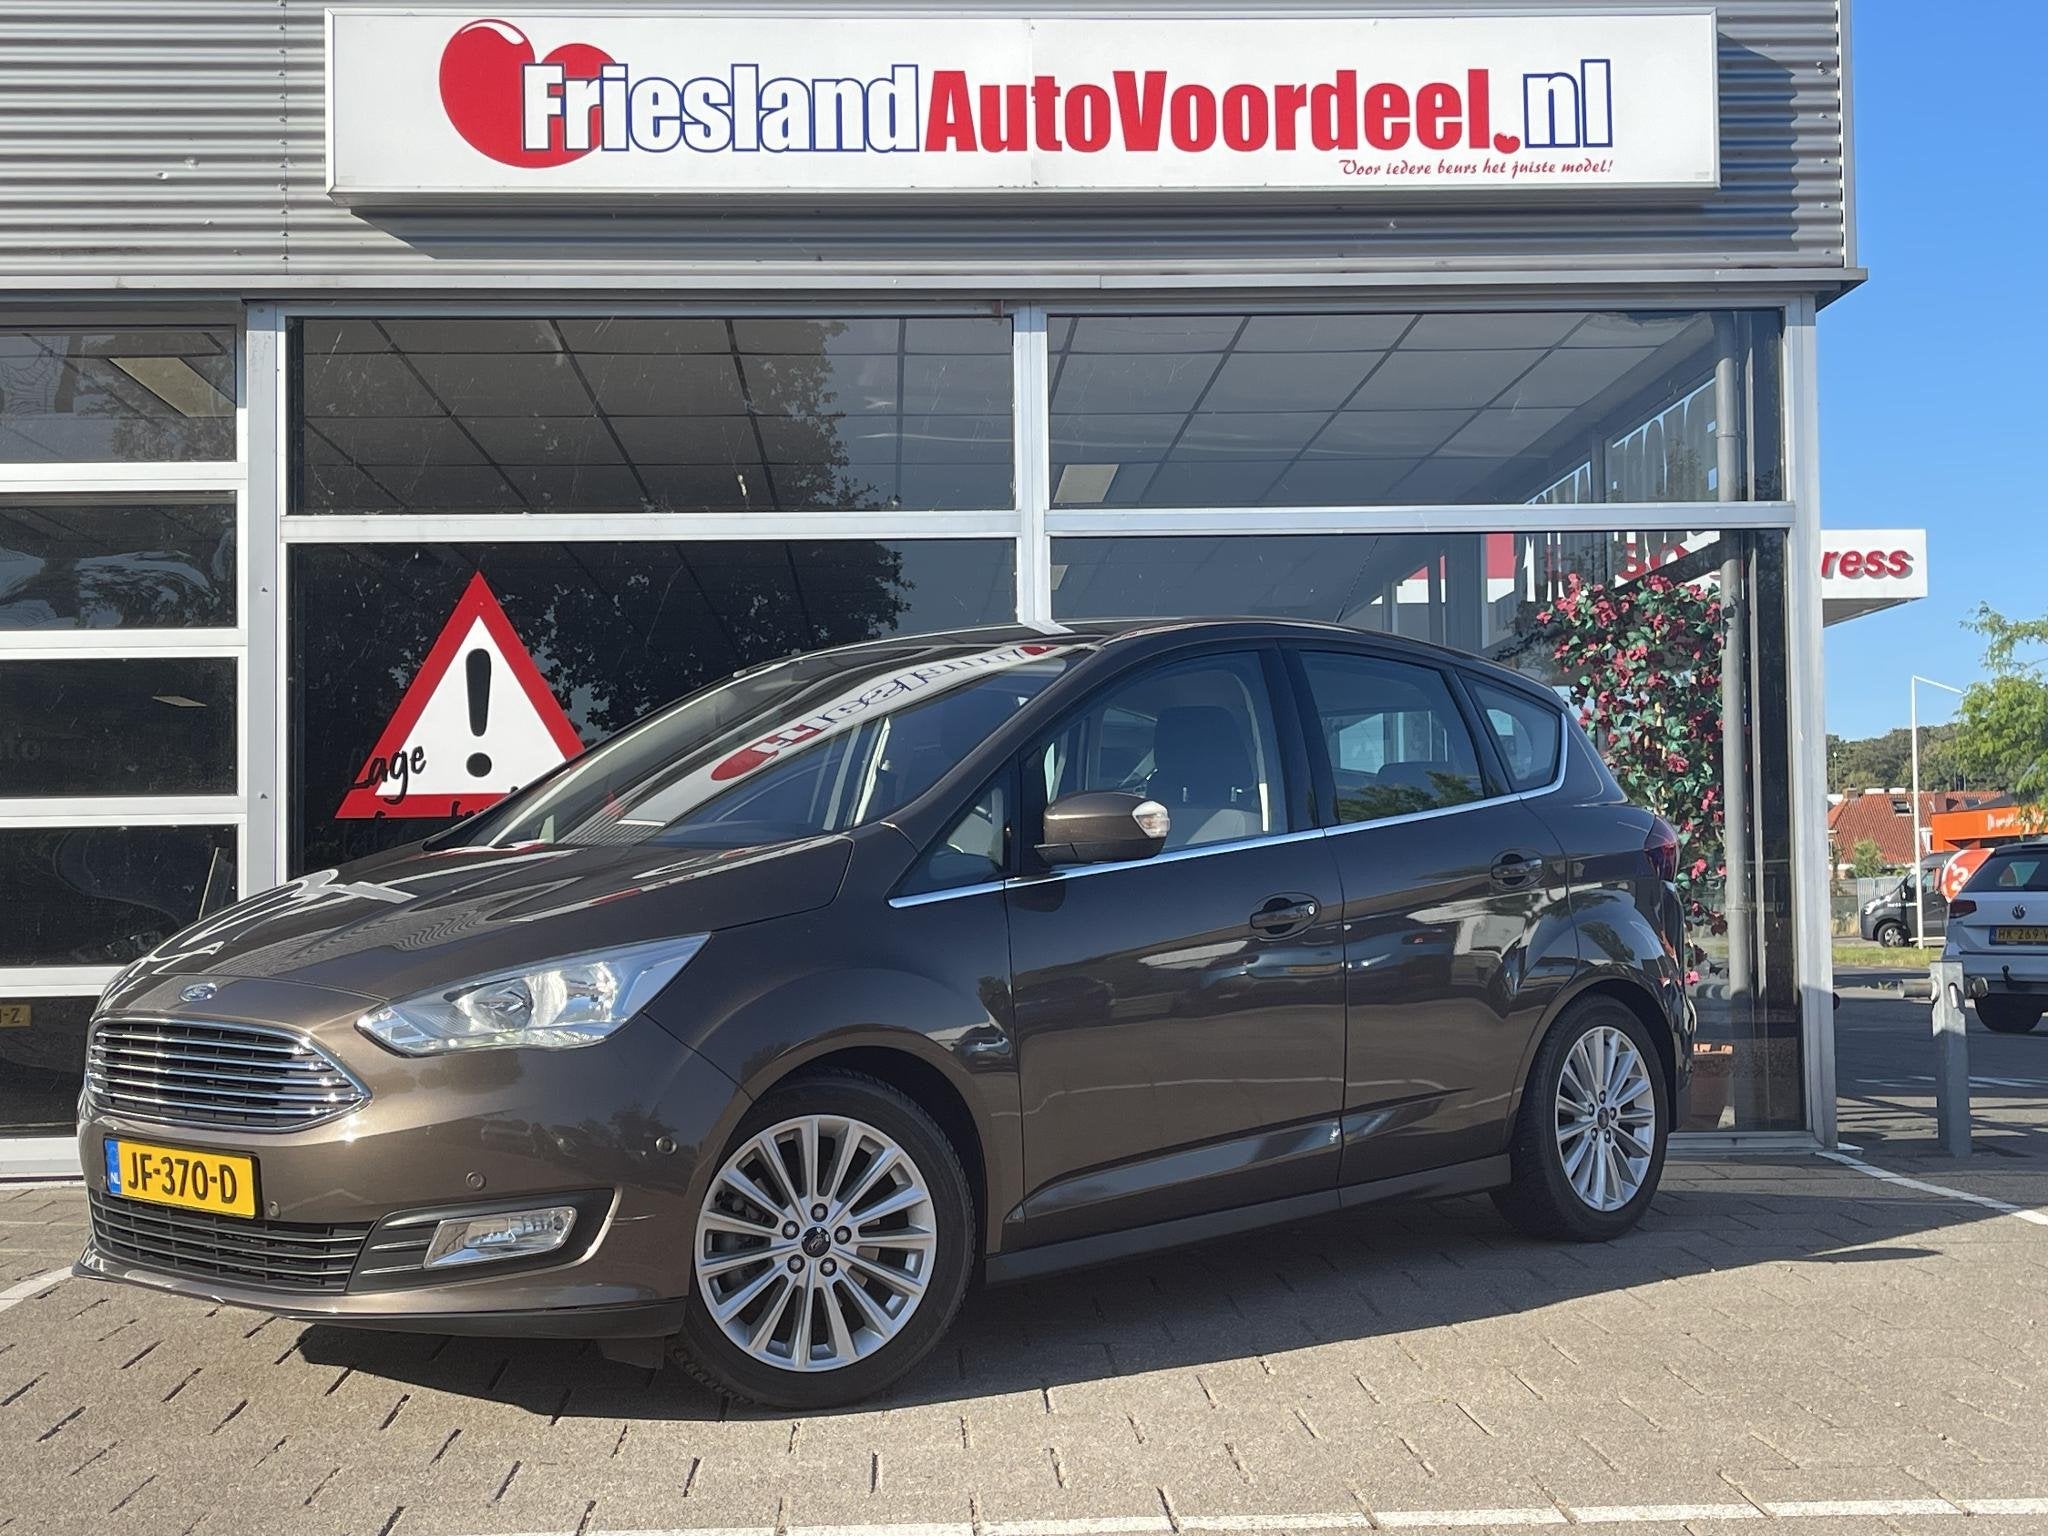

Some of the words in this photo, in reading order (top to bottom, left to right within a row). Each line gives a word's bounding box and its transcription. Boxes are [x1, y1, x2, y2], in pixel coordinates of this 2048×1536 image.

[1339, 159, 1381, 175] Voor
[1387, 160, 1431, 175] iedere
[1438, 158, 1477, 174] beurs
[1483, 158, 1507, 174] het
[1512, 160, 1556, 179] juiste
[1561, 157, 1614, 174] model!
[351, 745, 427, 805] age
[127, 1151, 238, 1205] JF-370-D
